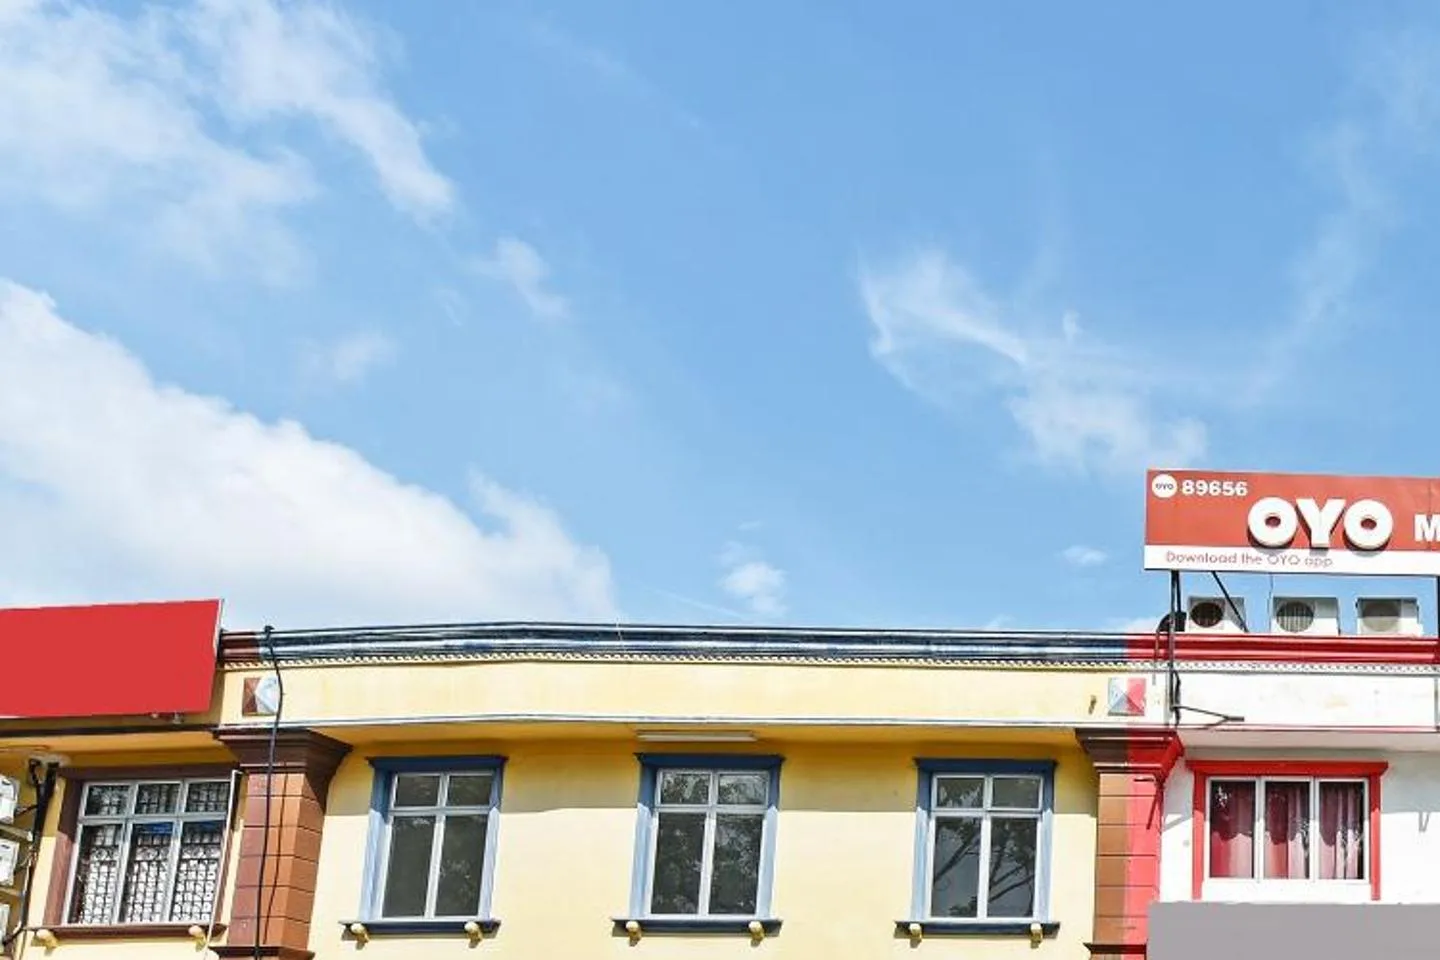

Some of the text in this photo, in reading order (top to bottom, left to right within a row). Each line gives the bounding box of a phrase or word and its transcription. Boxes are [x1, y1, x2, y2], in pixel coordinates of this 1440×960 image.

[1181, 479, 1249, 496] 89656
[1247, 496, 1394, 549] OYO
[1166, 551, 1237, 565] Download
[1241, 552, 1262, 565] the
[1304, 557, 1333, 568] app
